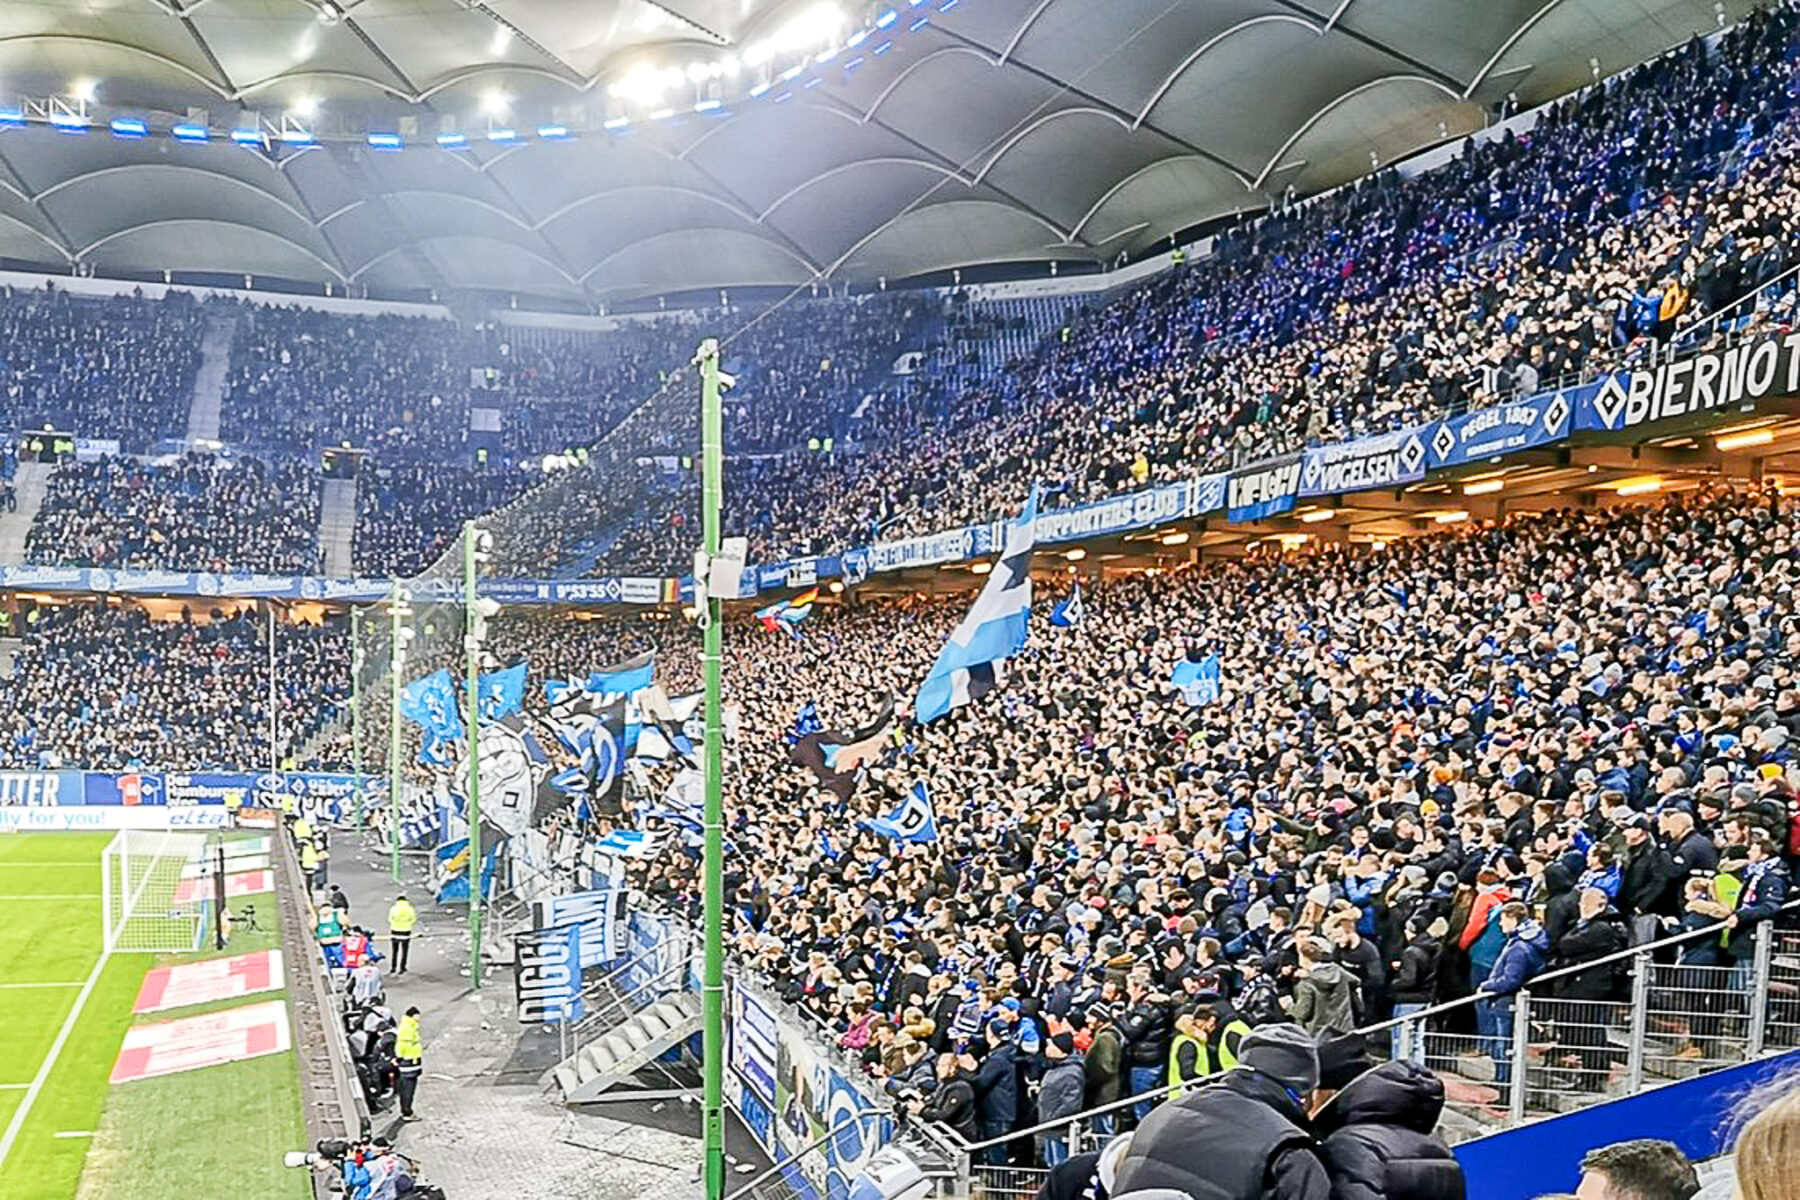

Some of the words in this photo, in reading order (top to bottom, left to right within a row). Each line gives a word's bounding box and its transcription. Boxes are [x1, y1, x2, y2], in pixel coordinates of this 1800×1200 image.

[1460, 408, 1502, 443] PEGEL
[1035, 502, 1132, 539] SUPPORTERS
[1134, 488, 1179, 524] CLUB
[165, 773, 192, 786] Der
[29, 810, 56, 825] for
[63, 810, 106, 830] you!
